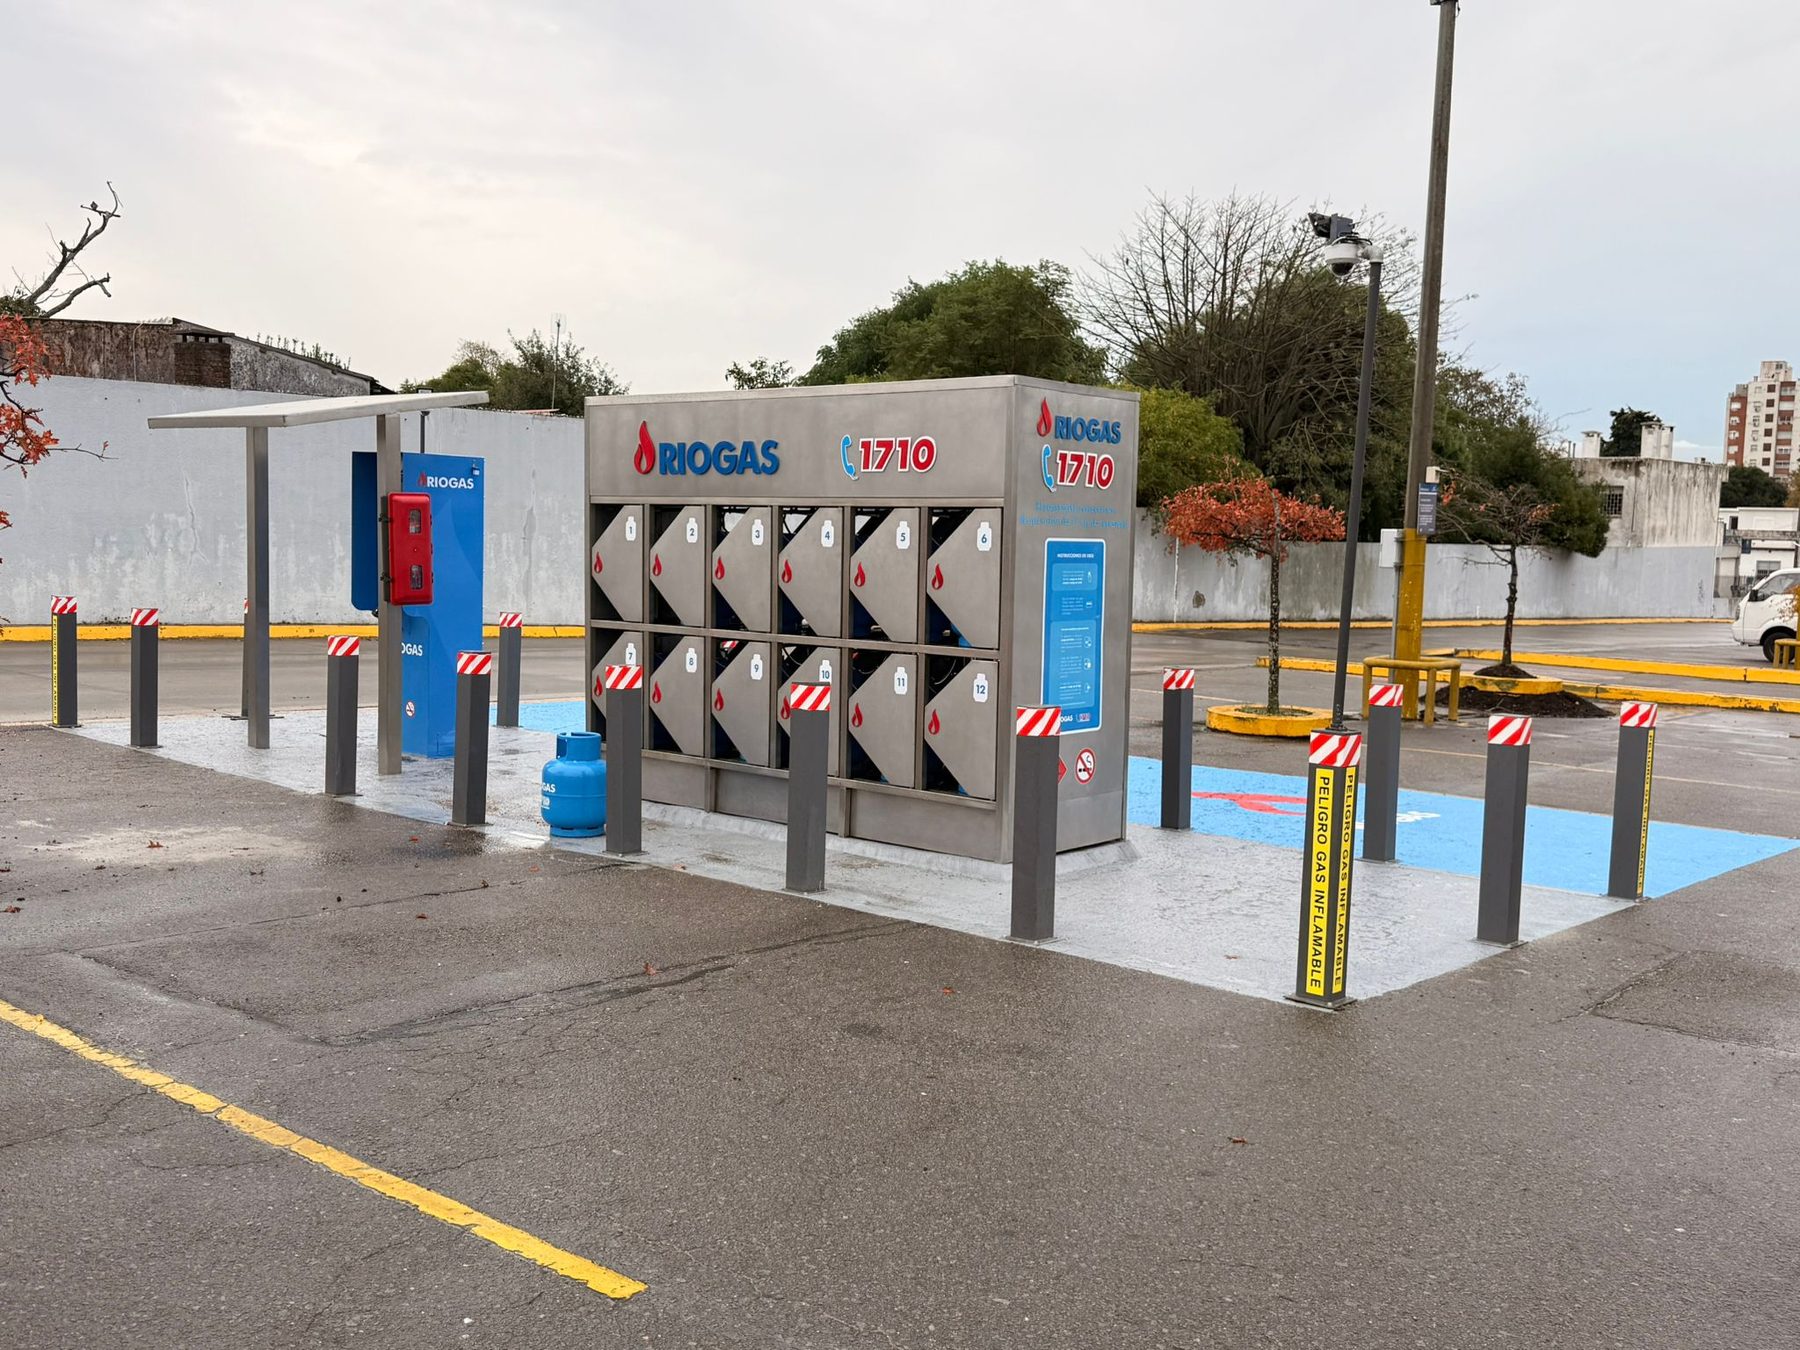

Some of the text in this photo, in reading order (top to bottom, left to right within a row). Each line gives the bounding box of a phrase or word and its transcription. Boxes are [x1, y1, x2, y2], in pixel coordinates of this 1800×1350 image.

[1054, 415, 1121, 444] RIOGAS
[659, 439, 779, 475] RIOGAS
[859, 436, 936, 473] 1710
[1057, 450, 1114, 489] 1710
[426, 476, 474, 489] RIOGAS
[629, 526, 633, 534] 1
[690, 528, 695, 536] 2
[755, 530, 760, 538] 3
[825, 531, 830, 540] 4
[900, 533, 906, 542] 5
[981, 534, 987, 543] 6
[689, 657, 694, 665] 8
[754, 664, 759, 672] 9
[821, 670, 830, 679] 10
[897, 678, 905, 687] 11
[976, 685, 985, 694] 12
[1310, 776, 1330, 988] PELIGRO GAS INFLAMABLE
[1335, 774, 1353, 986] PELIGRO GAS INFLAMABLE
